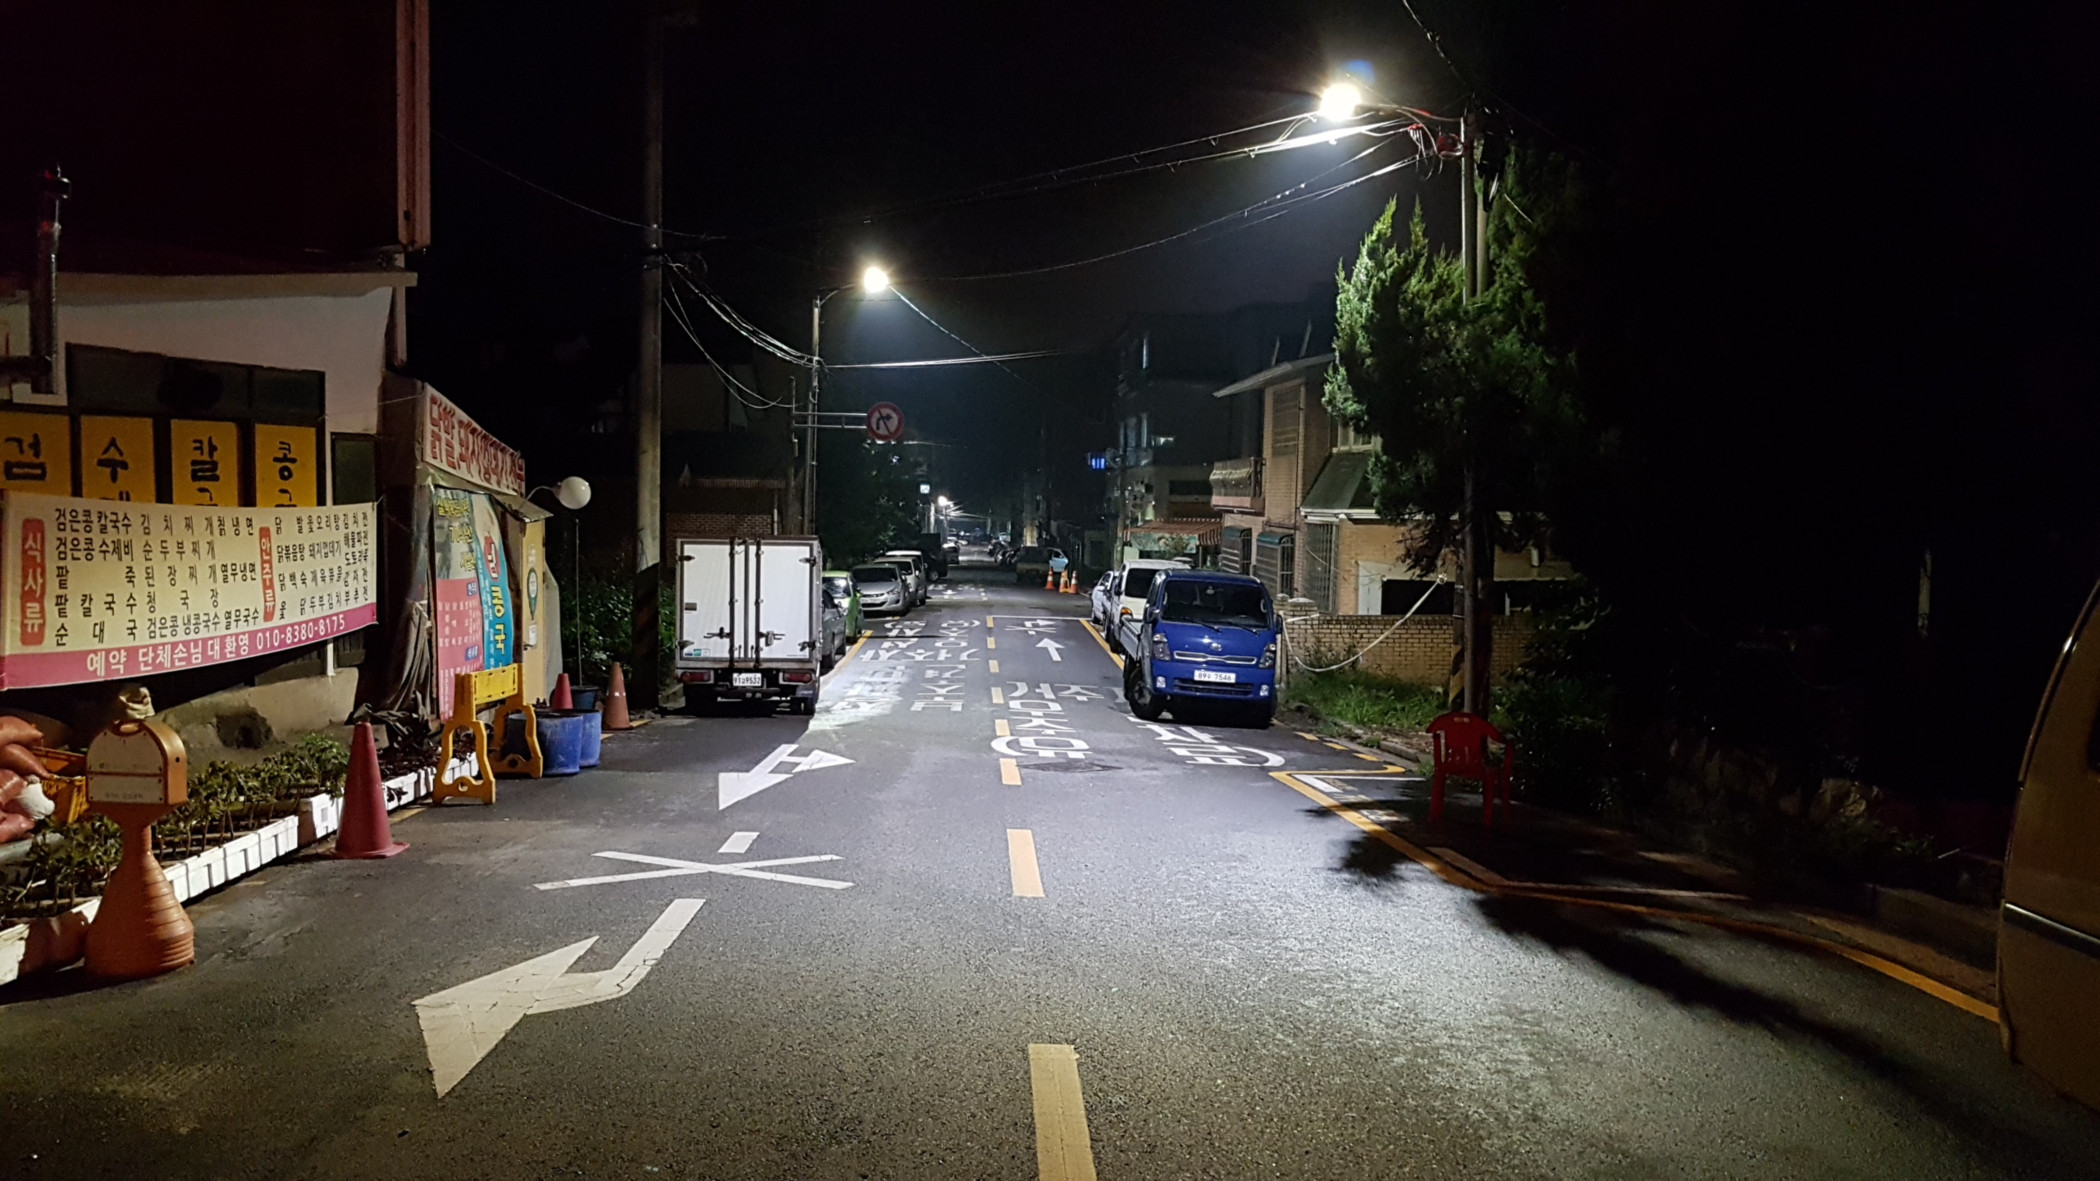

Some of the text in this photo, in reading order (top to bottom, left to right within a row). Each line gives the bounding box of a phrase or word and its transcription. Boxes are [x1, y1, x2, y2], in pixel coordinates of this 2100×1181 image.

[5, 433, 47, 481] 검
[55, 508, 94, 533] 검은콩
[97, 511, 132, 535] 칼국수
[56, 537, 95, 562] 검은콩
[99, 538, 134, 562] 수제비
[24, 532, 43, 633] 식사류
[220, 562, 256, 584] 열무냉면
[261, 537, 275, 613] 안주류
[148, 615, 179, 640] 검은콩
[183, 611, 221, 636] 냉콩국수
[224, 606, 260, 631] 열무국수
[87, 648, 127, 678] 예약
[256, 614, 345, 650] 010-8380-8175
